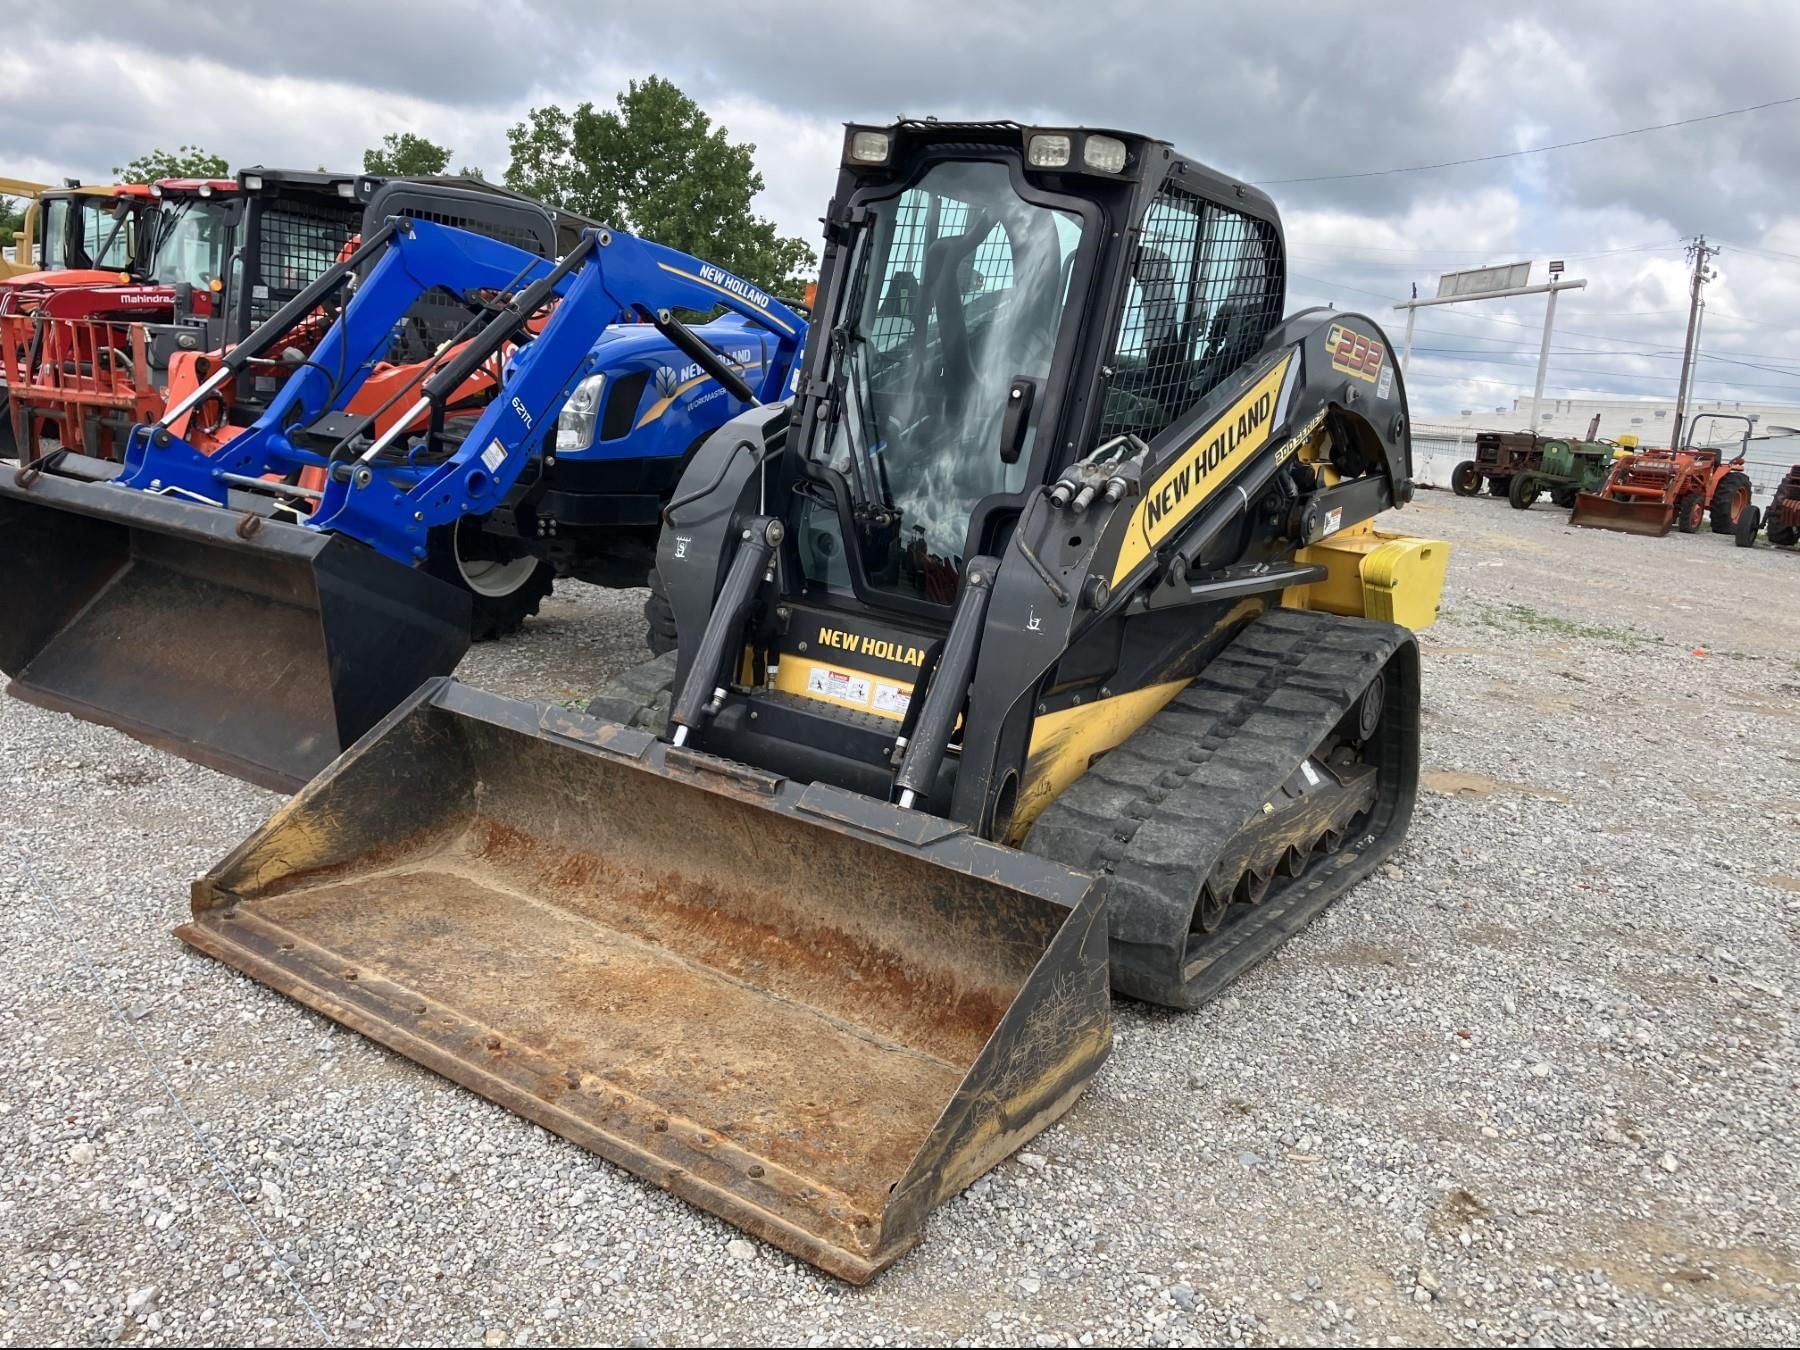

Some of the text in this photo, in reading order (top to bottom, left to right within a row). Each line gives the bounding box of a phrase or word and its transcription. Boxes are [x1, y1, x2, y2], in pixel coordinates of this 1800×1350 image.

[120, 294, 170, 304] Mahindra
[699, 264, 769, 308] NEW HOLLAND
[1147, 391, 1270, 531] NEW HOLLAND
[1275, 438, 1296, 466] 200
[818, 627, 926, 667] NEW HOLLAN
